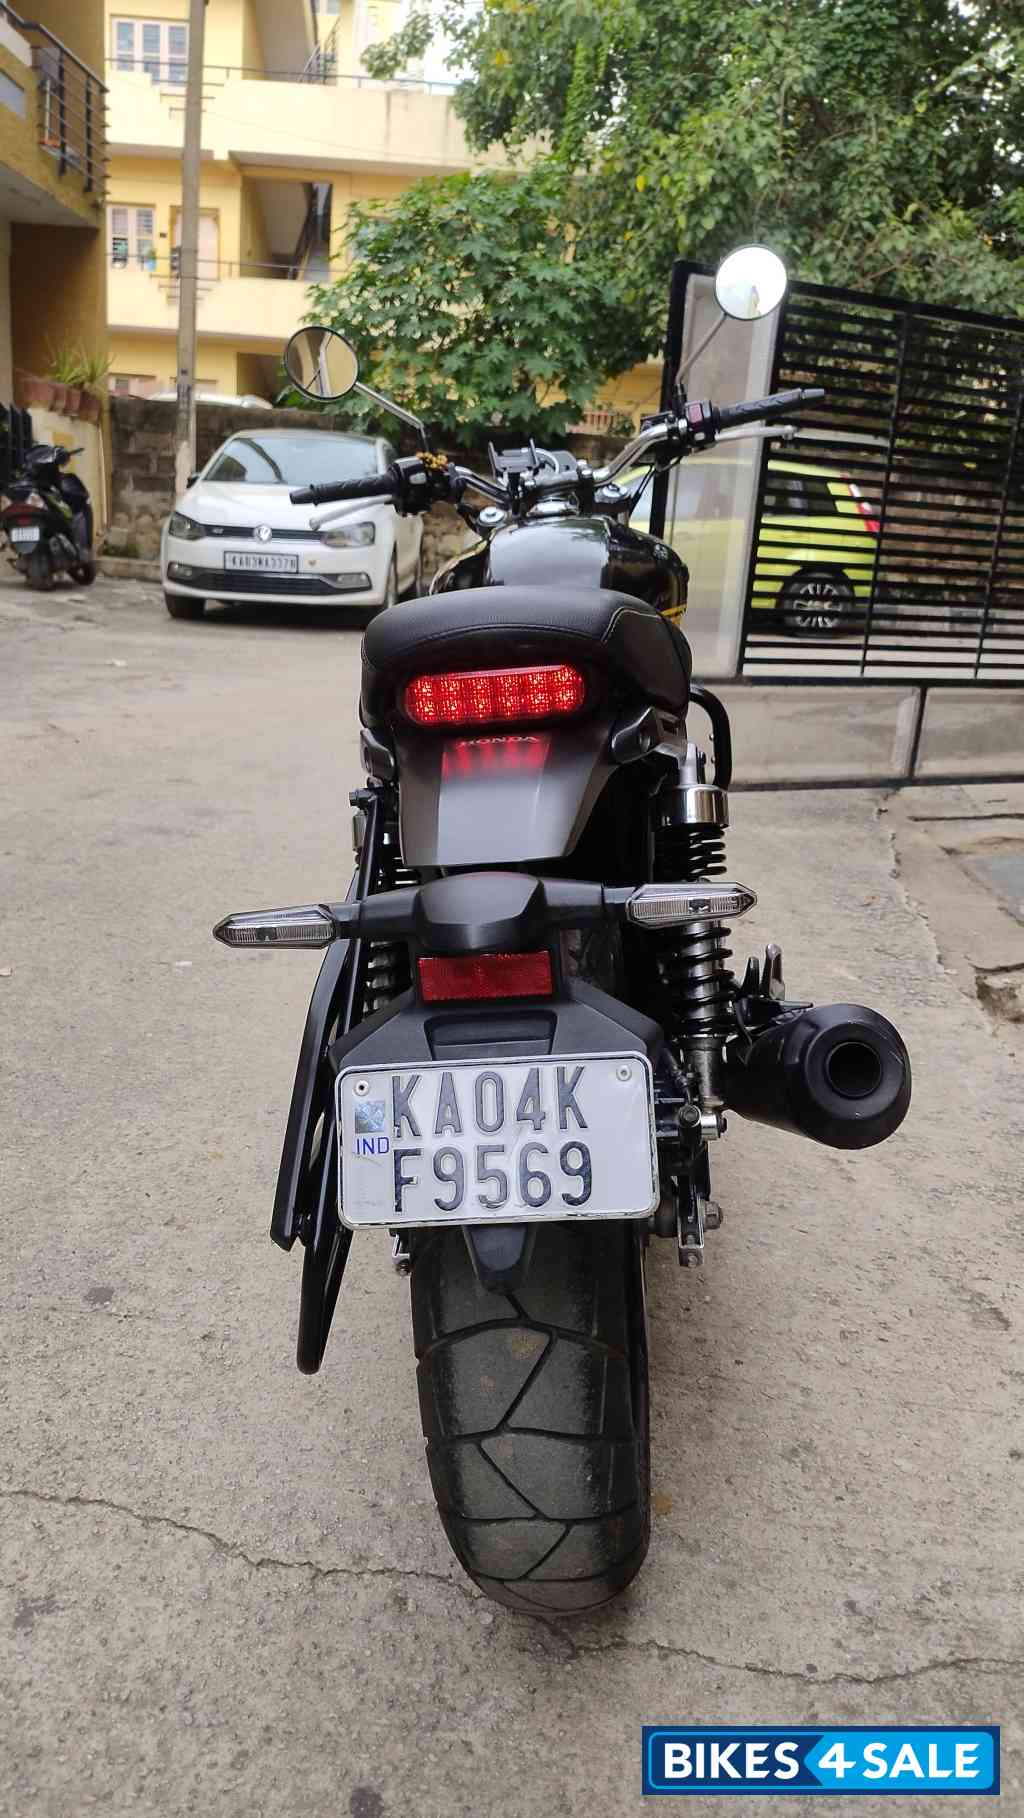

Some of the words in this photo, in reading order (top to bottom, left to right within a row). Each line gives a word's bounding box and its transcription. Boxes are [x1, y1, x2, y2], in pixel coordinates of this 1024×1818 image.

[457, 736, 540, 747] HONDA
[391, 1065, 588, 1138] KA04K
[356, 1136, 390, 1155] IND
[393, 1140, 593, 1213] F9569
